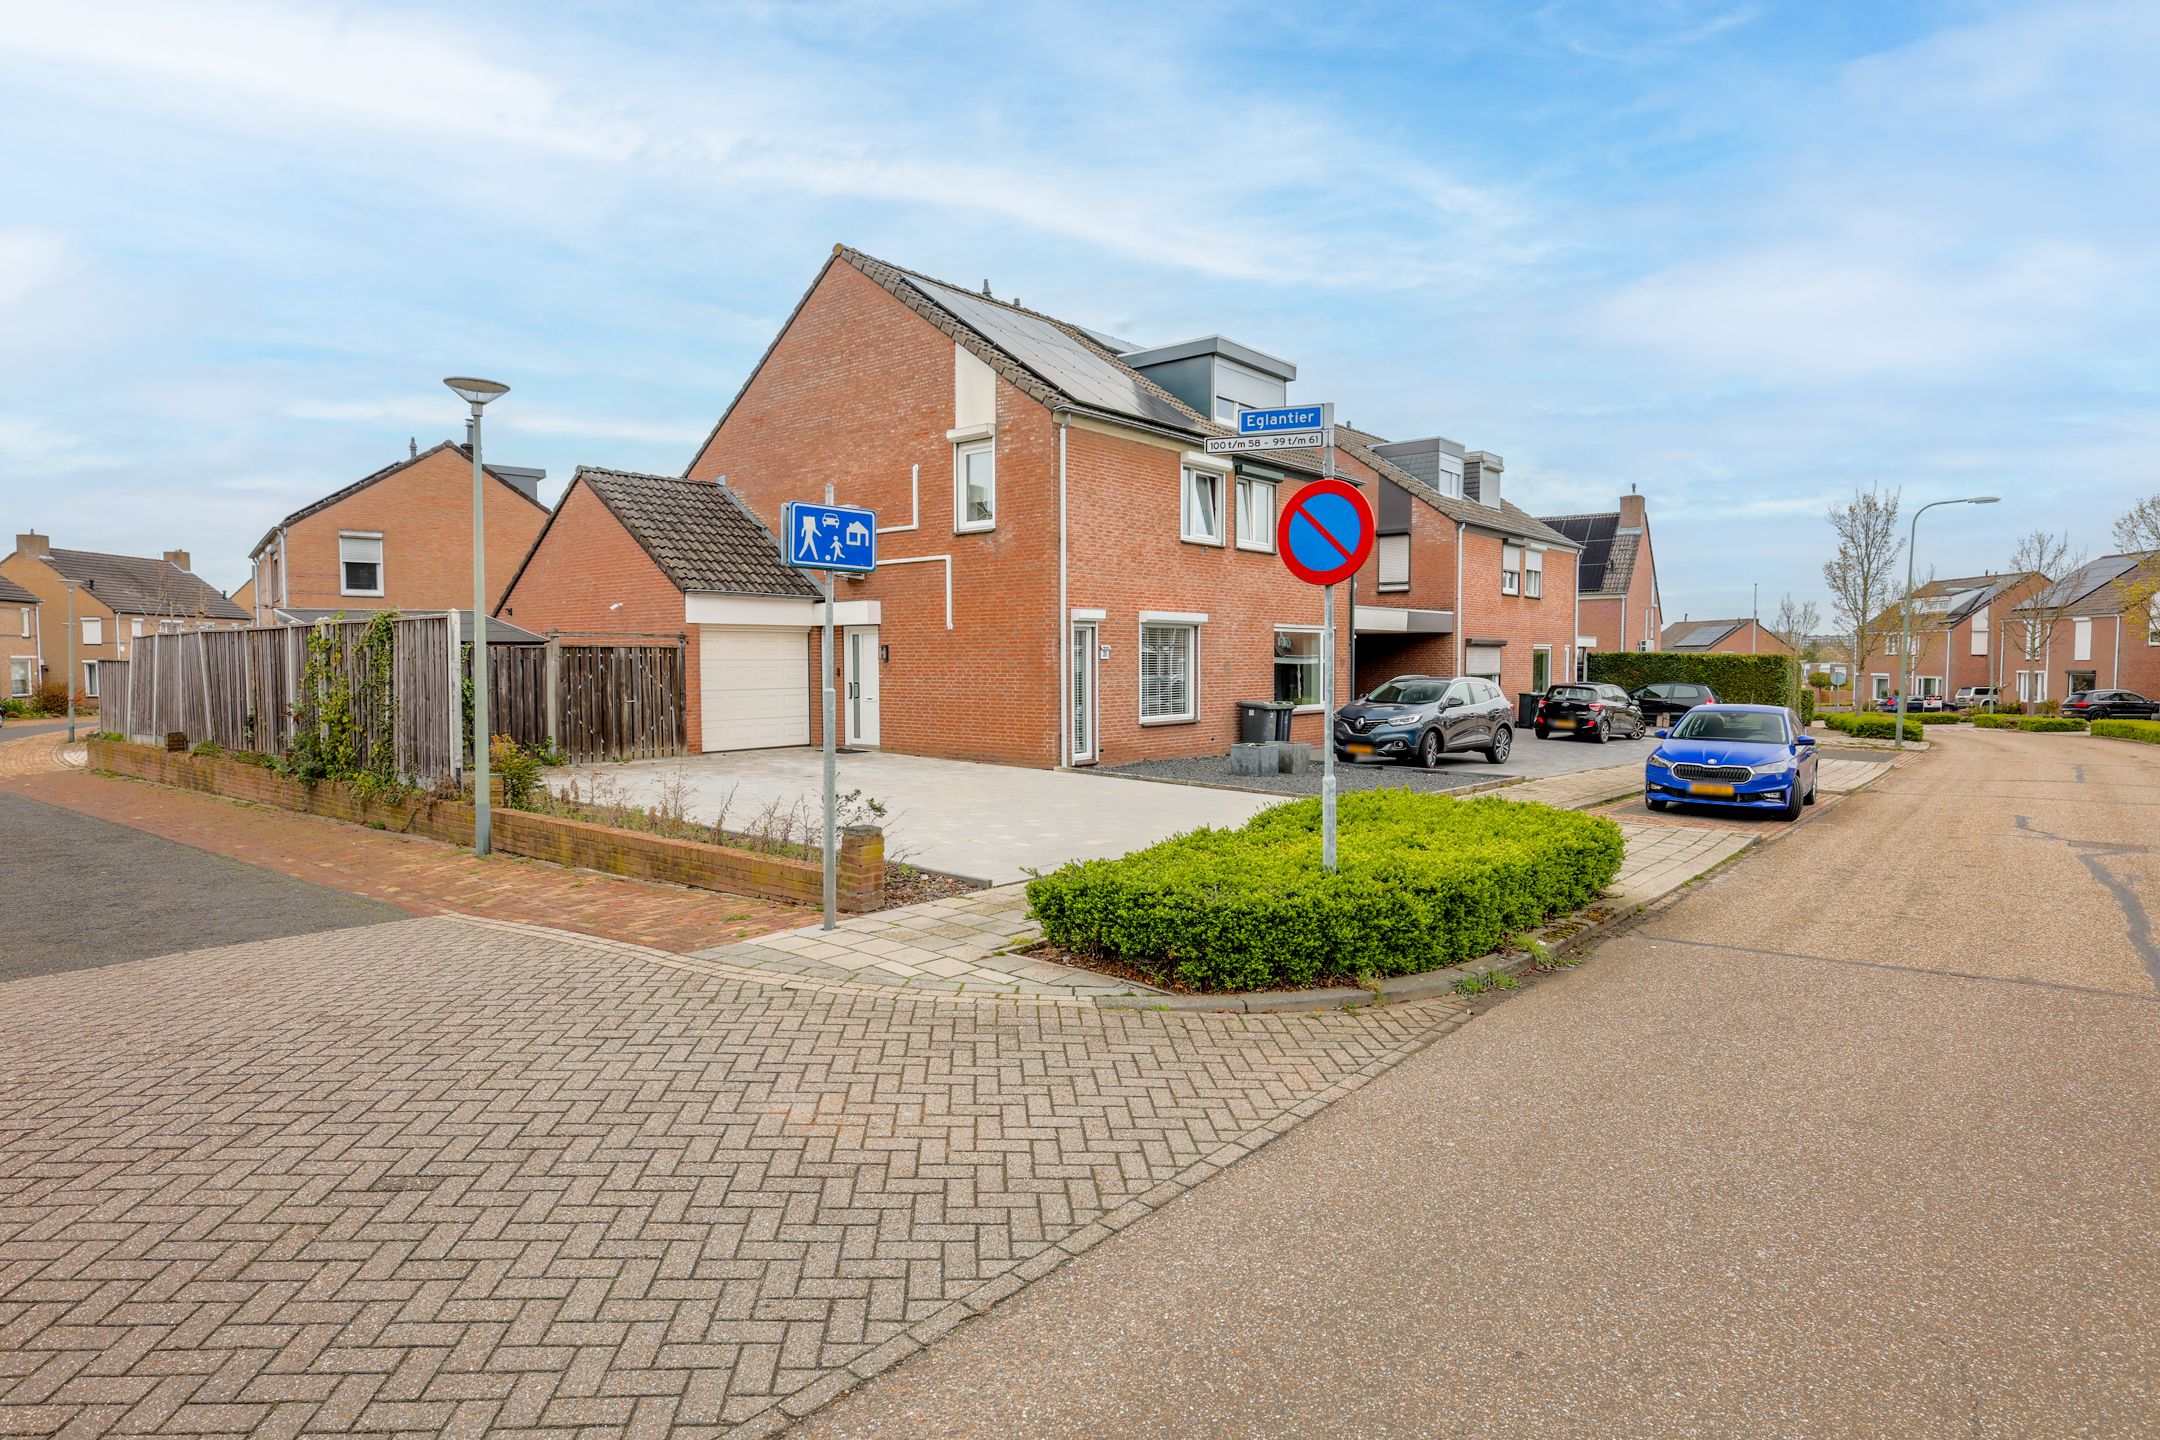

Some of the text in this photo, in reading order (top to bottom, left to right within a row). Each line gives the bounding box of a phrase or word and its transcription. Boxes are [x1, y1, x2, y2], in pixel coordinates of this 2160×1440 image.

[1246, 411, 1315, 429] Eglantier
[1210, 441, 1226, 450] 100
[1228, 440, 1246, 449] t/m
[1248, 439, 1261, 447] 58
[1272, 437, 1285, 446] 99
[1288, 436, 1306, 445] t/m
[1308, 435, 1319, 444] 61
